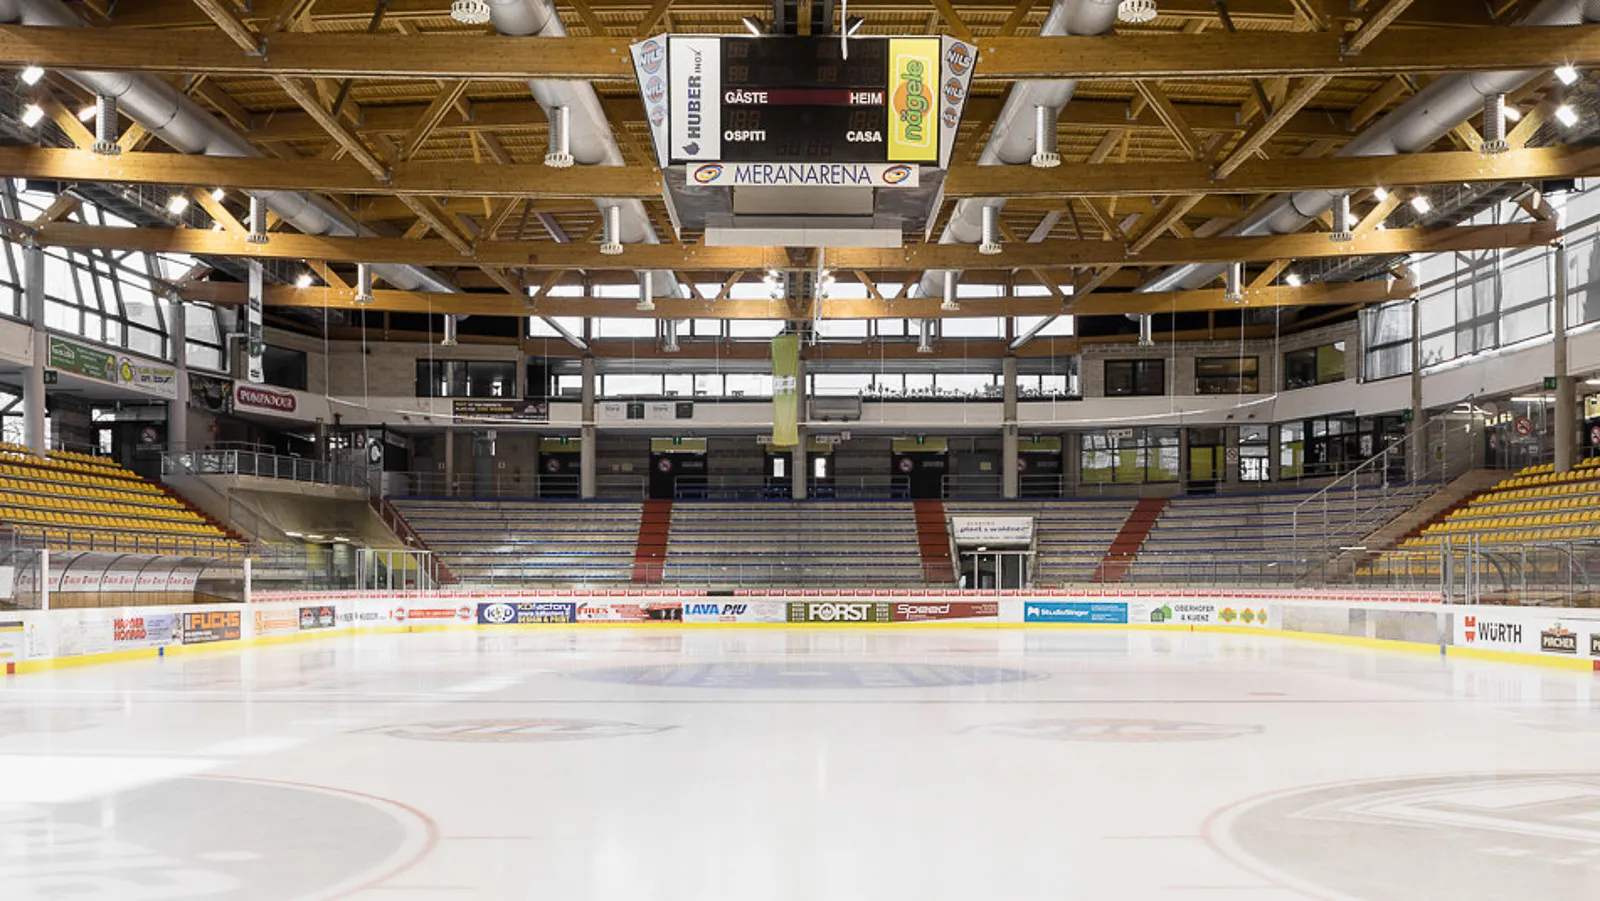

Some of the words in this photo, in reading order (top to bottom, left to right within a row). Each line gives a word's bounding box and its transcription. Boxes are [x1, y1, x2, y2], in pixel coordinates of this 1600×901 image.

[724, 88, 768, 104] GÄSTE
[850, 92, 883, 104] HEIM
[901, 59, 929, 141] nägele
[687, 75, 702, 138] HUBER
[724, 130, 766, 142] OSPITI
[846, 130, 882, 142] CASA
[734, 164, 872, 184] MERANARENA
[685, 604, 719, 615] LAVA
[808, 603, 872, 621] FORST
[897, 604, 950, 620] Speed
[191, 611, 240, 630] FUCHS
[1478, 621, 1522, 643] WÜRTH
